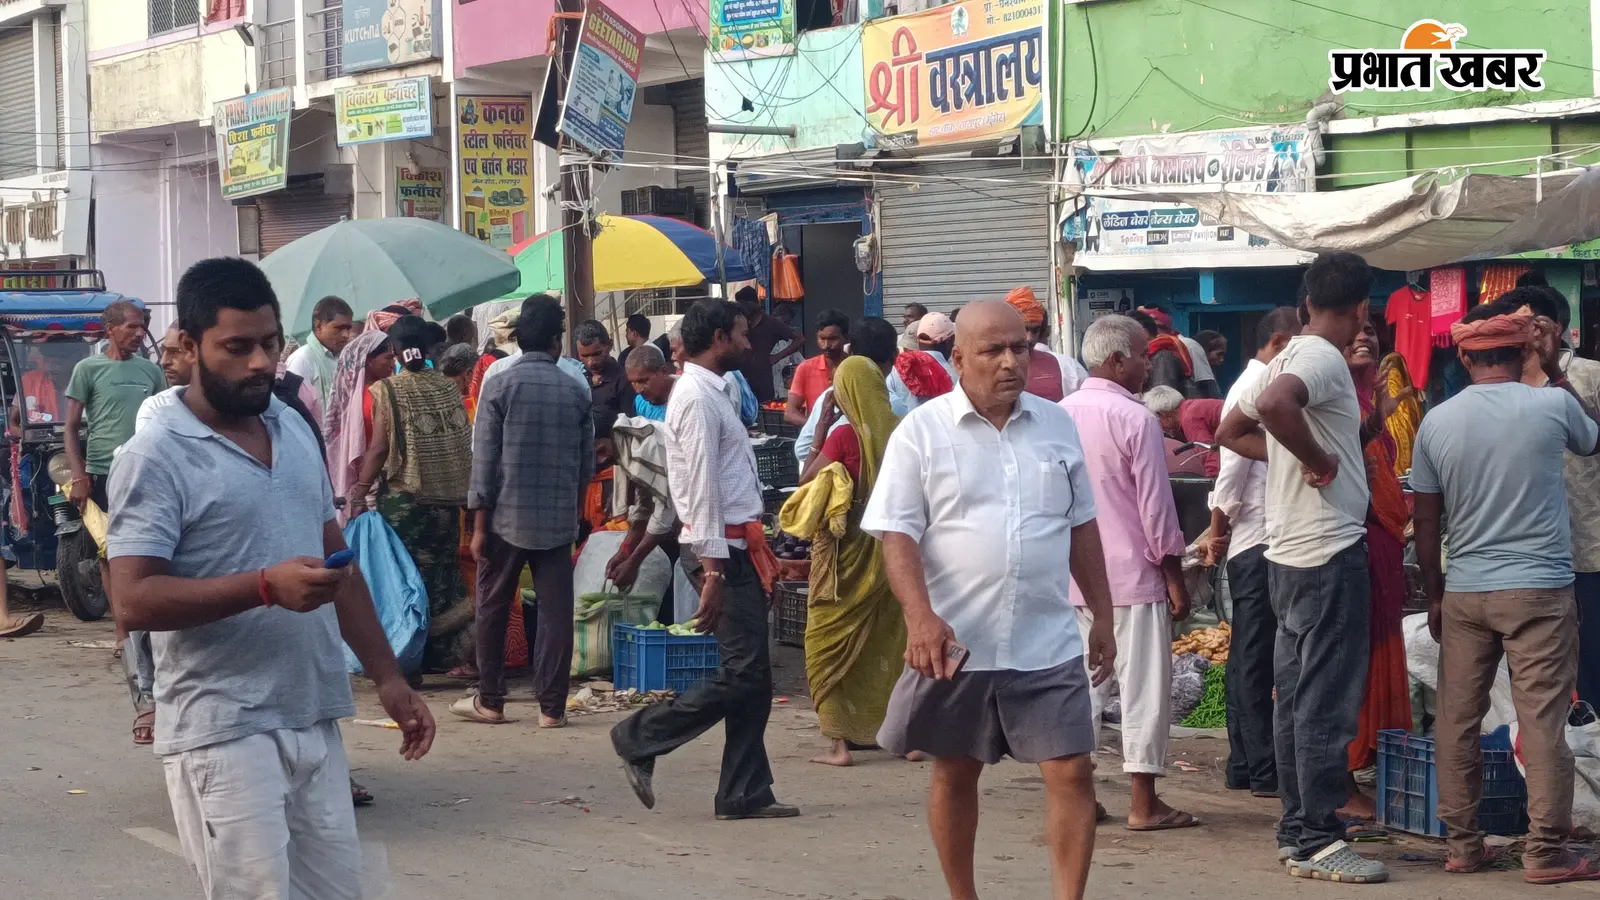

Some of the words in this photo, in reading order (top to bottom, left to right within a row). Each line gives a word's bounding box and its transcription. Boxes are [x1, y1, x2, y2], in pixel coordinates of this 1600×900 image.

[588, 13, 640, 65] GEETARJUN
[866, 26, 923, 129] श्री
[925, 26, 1043, 114] वस्त्रालय
[481, 102, 527, 125] कनक
[463, 129, 489, 149] स्टील
[492, 129, 528, 149] फर्निचर
[506, 152, 528, 176] भंडार
[1150, 155, 1207, 183] वस्त्रालय
[1175, 210, 1197, 224] वेयर
